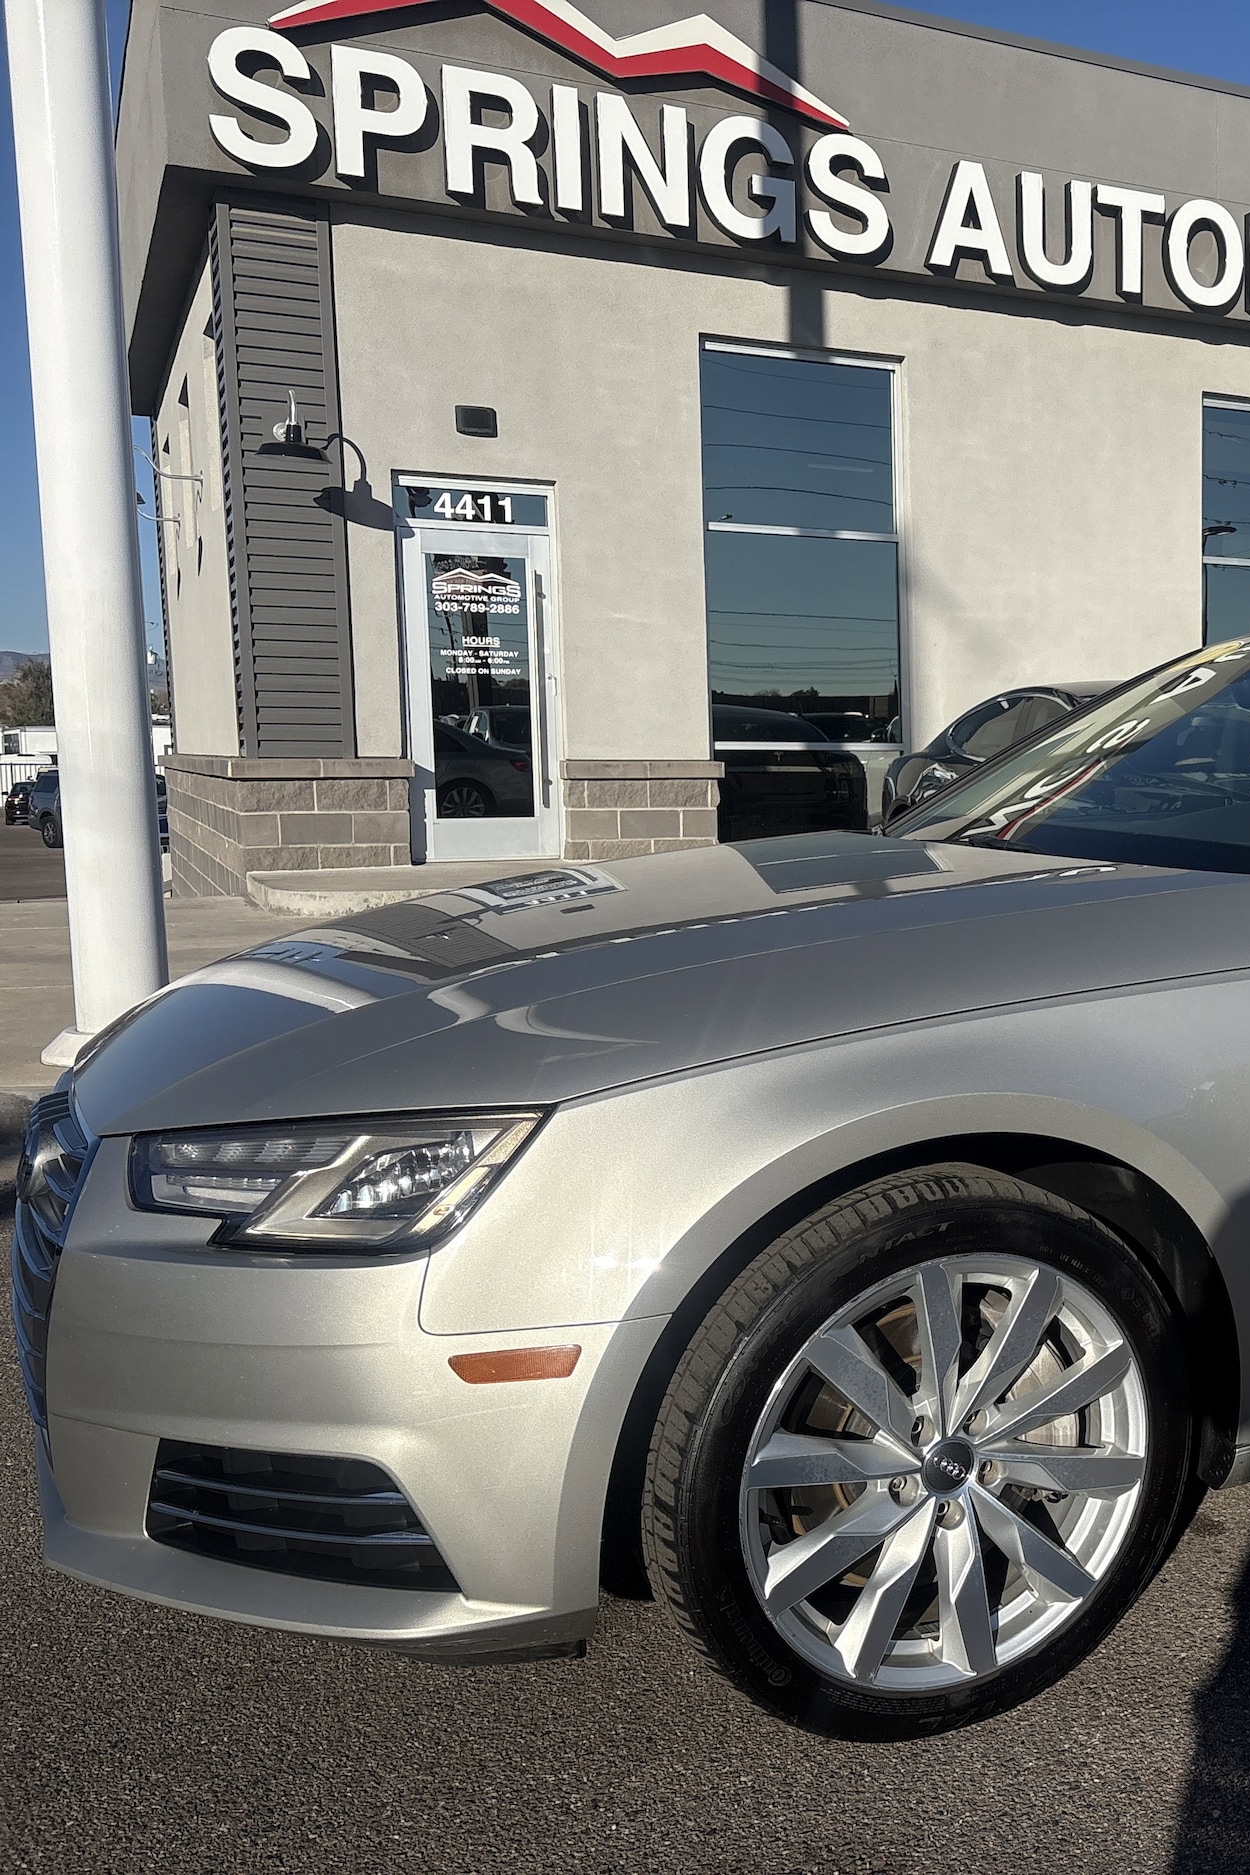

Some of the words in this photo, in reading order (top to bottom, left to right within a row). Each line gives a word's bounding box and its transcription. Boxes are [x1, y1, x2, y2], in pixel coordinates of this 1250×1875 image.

[207, 25, 890, 256] SPRINGS
[433, 492, 513, 523] 4411
[431, 581, 522, 598] SPRINGS
[434, 595, 489, 603] AUTOMOTIVE
[434, 601, 520, 614] 303-789-2886
[462, 636, 501, 647] HOURS
[440, 649, 473, 657] MONDAY
[478, 650, 519, 658] SATURDAY
[445, 667, 477, 675] CLOSED
